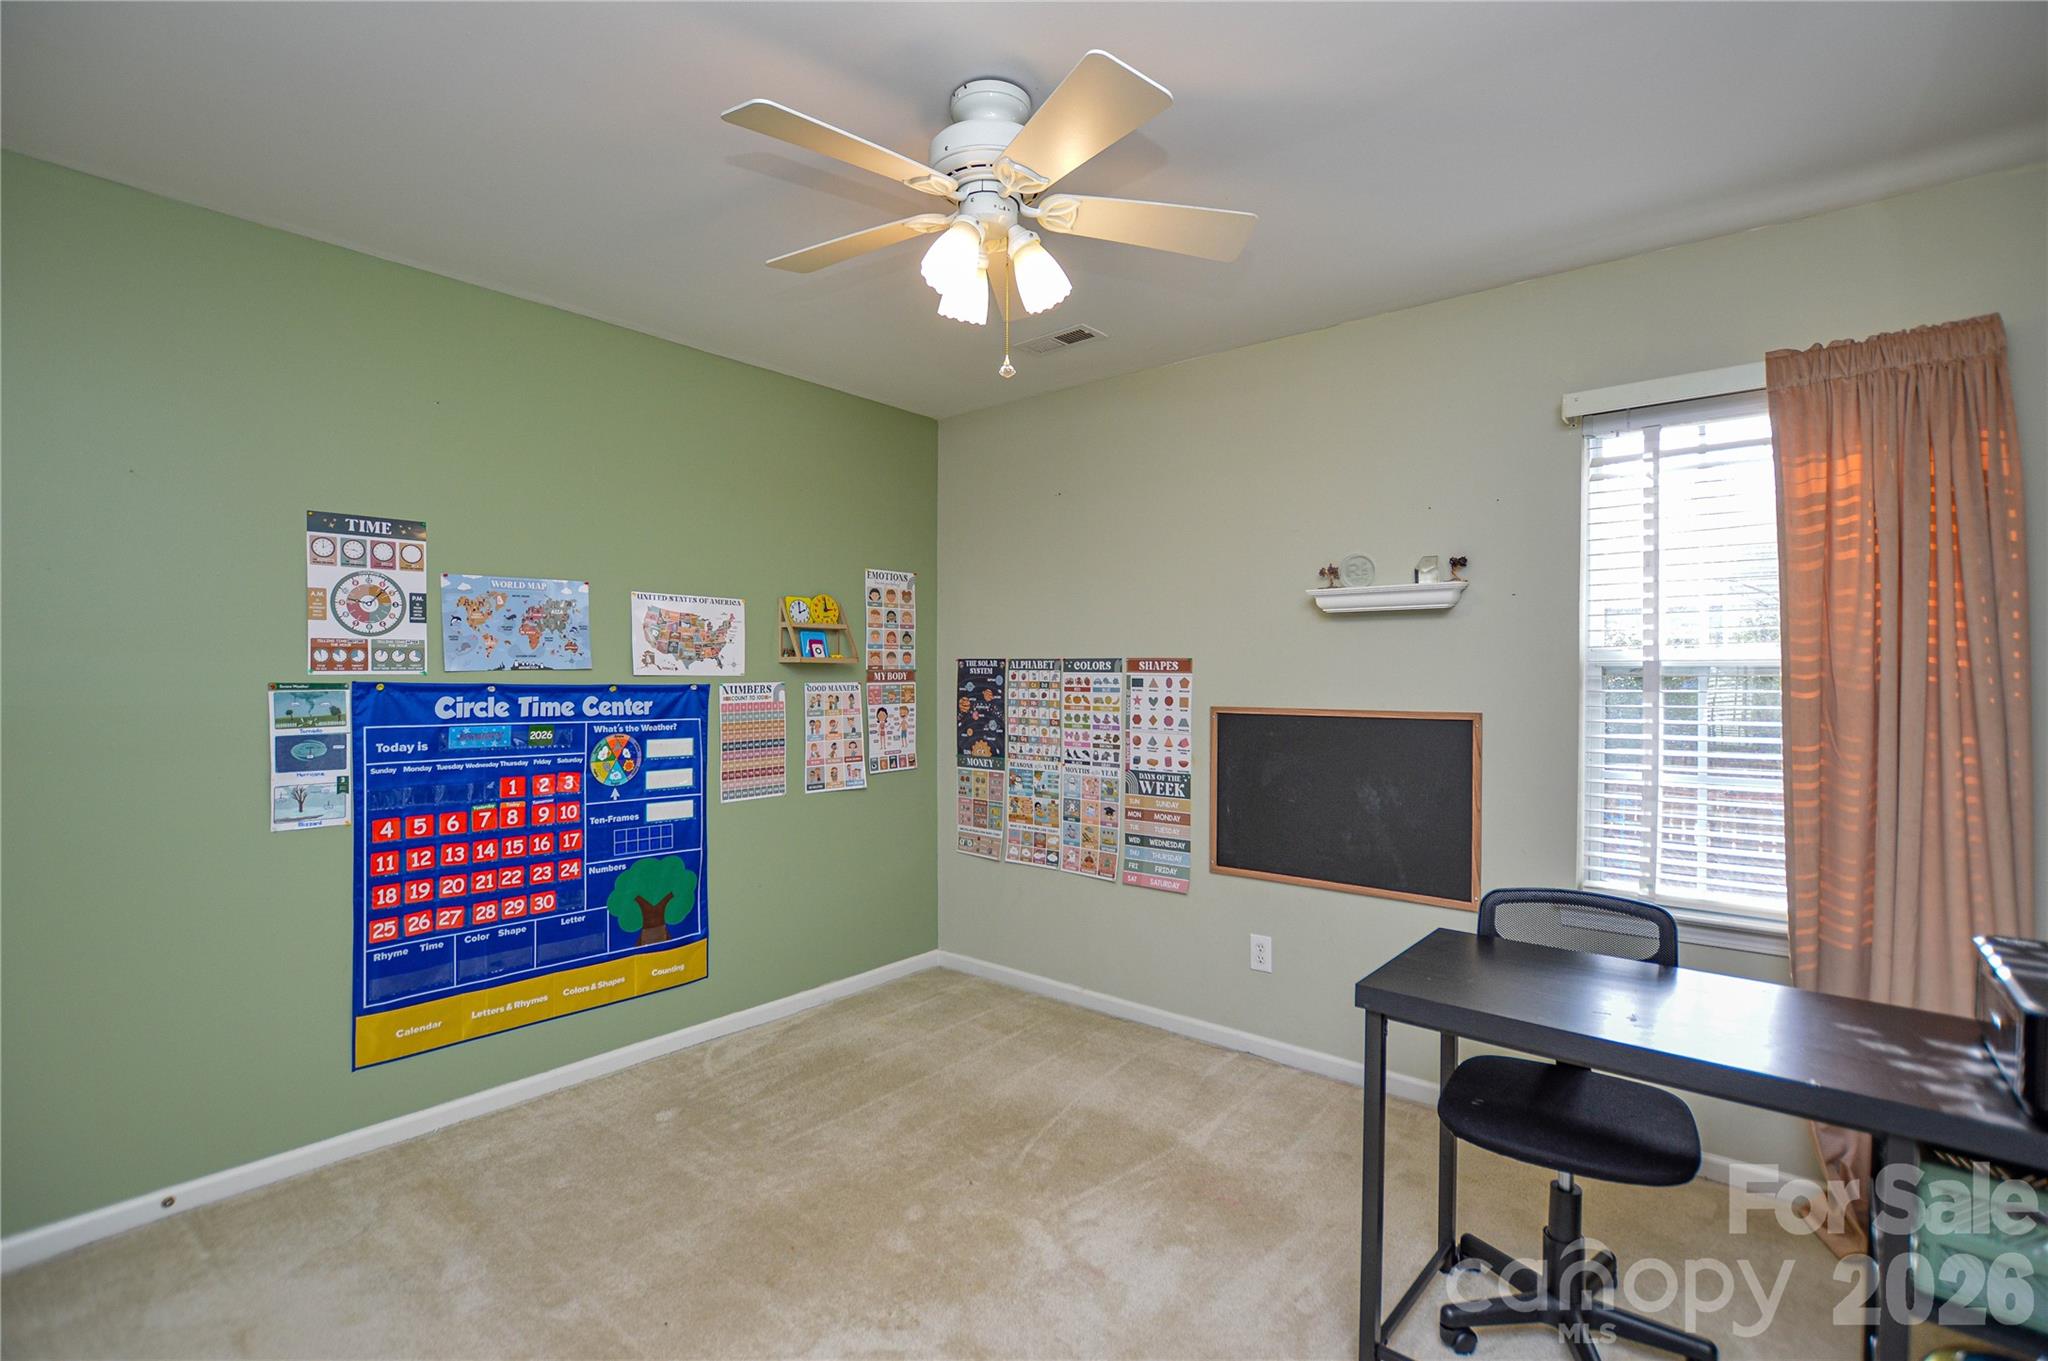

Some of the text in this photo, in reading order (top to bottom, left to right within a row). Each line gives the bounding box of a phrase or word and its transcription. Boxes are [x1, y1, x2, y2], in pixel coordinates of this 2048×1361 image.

[345, 518, 392, 535] TIME
[867, 570, 908, 582] EMOTIONS
[491, 580, 547, 590] WORLD MAP
[709, 598, 741, 606] AMERICA
[1010, 660, 1054, 669] ALPHABET
[1073, 661, 1112, 670] COLORS
[1139, 661, 1178, 671] SHAPES
[874, 672, 908, 680] MY BODY
[722, 684, 772, 694] NUMBERS
[435, 696, 654, 720] Circle Time Center
[594, 723, 677, 733] What's the Weather?
[530, 730, 553, 740] 2026
[375, 741, 428, 754] Today is
[370, 766, 397, 775] Sunday
[402, 764, 432, 773] Monday
[436, 763, 464, 771] Tuesday
[465, 761, 500, 769] Wednesday
[967, 758, 993, 768] MONEY
[1101, 769, 1118, 777] YEAR
[509, 776, 573, 792] 1 2 3
[1139, 780, 1185, 797] WEEK
[1156, 799, 1179, 808] SUNDAY
[380, 805, 577, 838] 4 5 6 7 8 9 10
[590, 814, 639, 825] Ten-Frames
[1154, 813, 1181, 822] MONDAY
[1154, 826, 1180, 834] TUESDAY
[1149, 839, 1186, 849] WEDNESDAY
[376, 833, 580, 872] 11 12 13 14 15 16 17
[1152, 851, 1183, 861] THURSDAY
[589, 864, 626, 875] Numbers
[1154, 866, 1178, 875] FRIDAY
[377, 862, 579, 905] 18 19 20 21 22 23 24
[1150, 879, 1180, 889] SATURDAY
[373, 895, 554, 939] 25 26 27 28 29 30
[561, 915, 585, 925] Letter
[464, 926, 527, 944] Color Shape
[373, 941, 444, 962] Rhyme Time
[651, 963, 685, 976] Counting
[563, 985, 589, 996] Colors
[597, 977, 625, 989] Shapes
[471, 1006, 505, 1020] Letters
[514, 994, 548, 1010] Rhymes
[395, 1020, 442, 1038] Calendar
